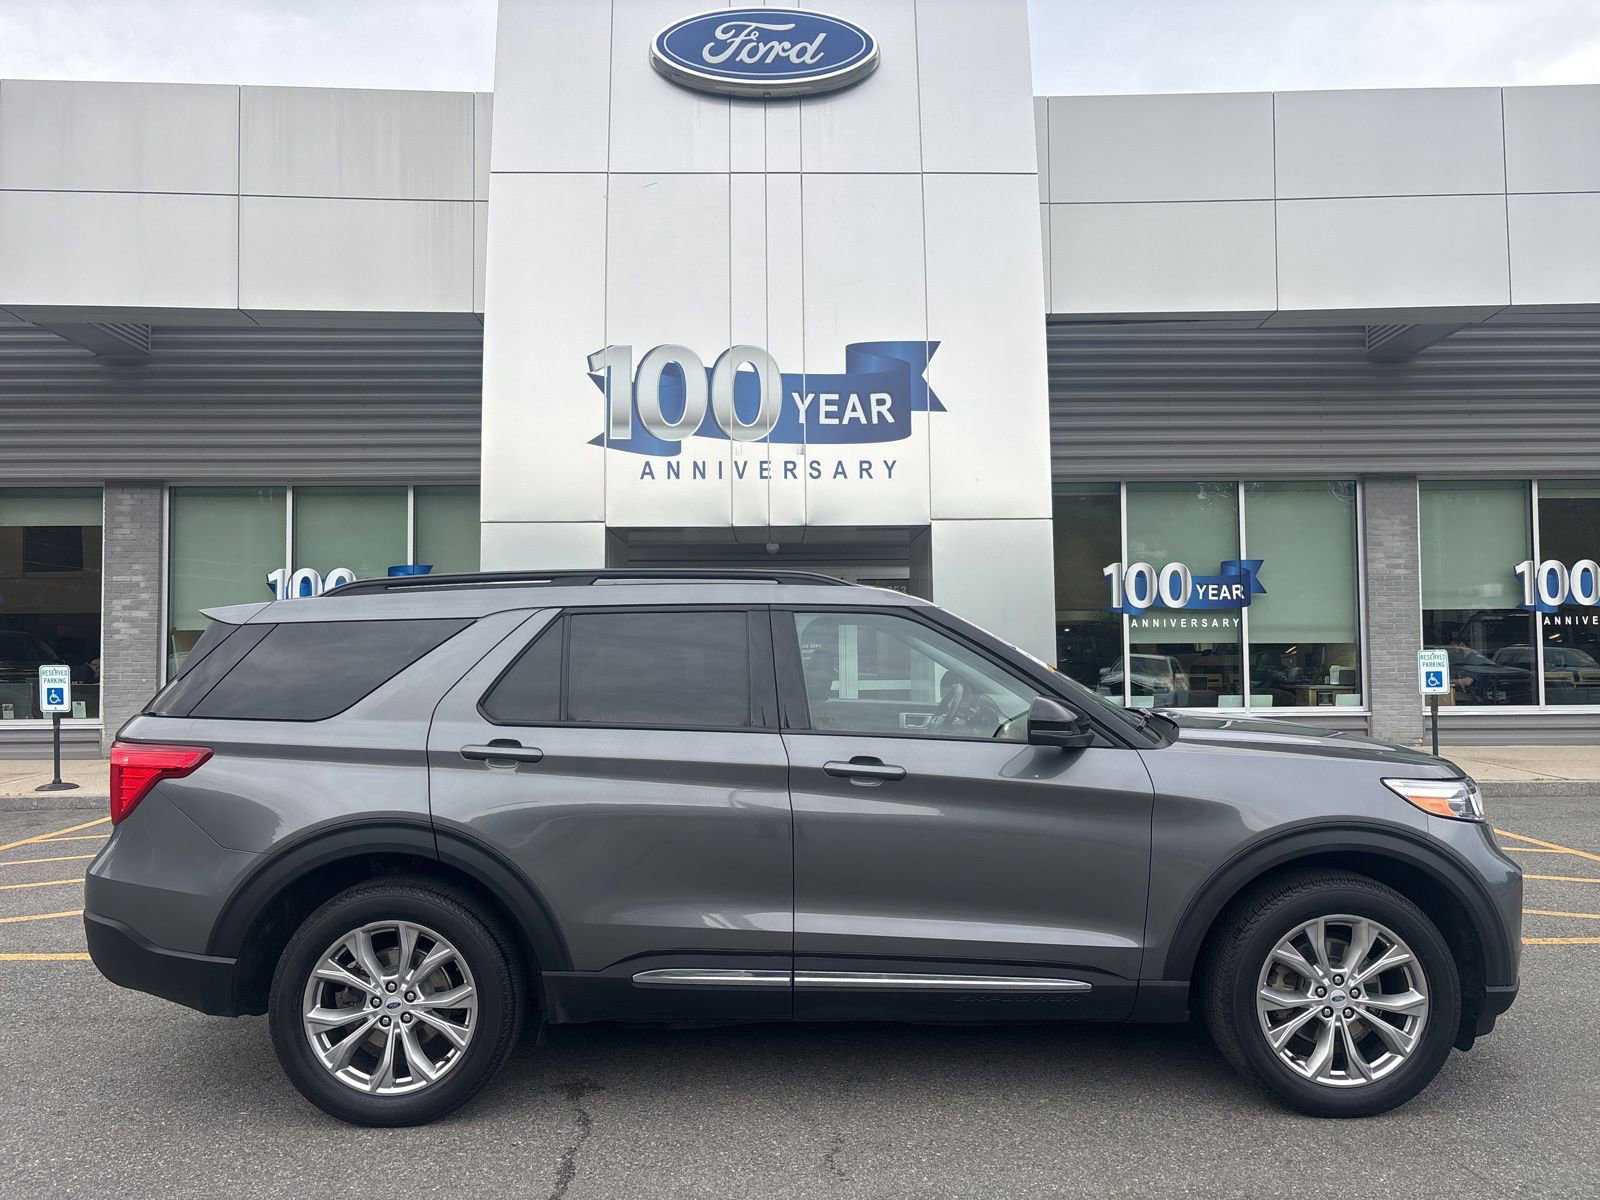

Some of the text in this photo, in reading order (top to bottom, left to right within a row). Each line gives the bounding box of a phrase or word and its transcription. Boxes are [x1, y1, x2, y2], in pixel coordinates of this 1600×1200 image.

[702, 21, 827, 65] Ford
[587, 343, 896, 443] 100 YEAR
[640, 459, 897, 480] ANNIVERSARY
[1103, 562, 1245, 609] 100 YEAR
[1514, 559, 1600, 606] 100
[1131, 618, 1240, 628] ANNIVERSARY
[1543, 615, 1599, 625] ANNIVE
[1420, 653, 1446, 661] RESERVED
[41, 669, 68, 677] RESERVED
[43, 677, 67, 685] PARKING
